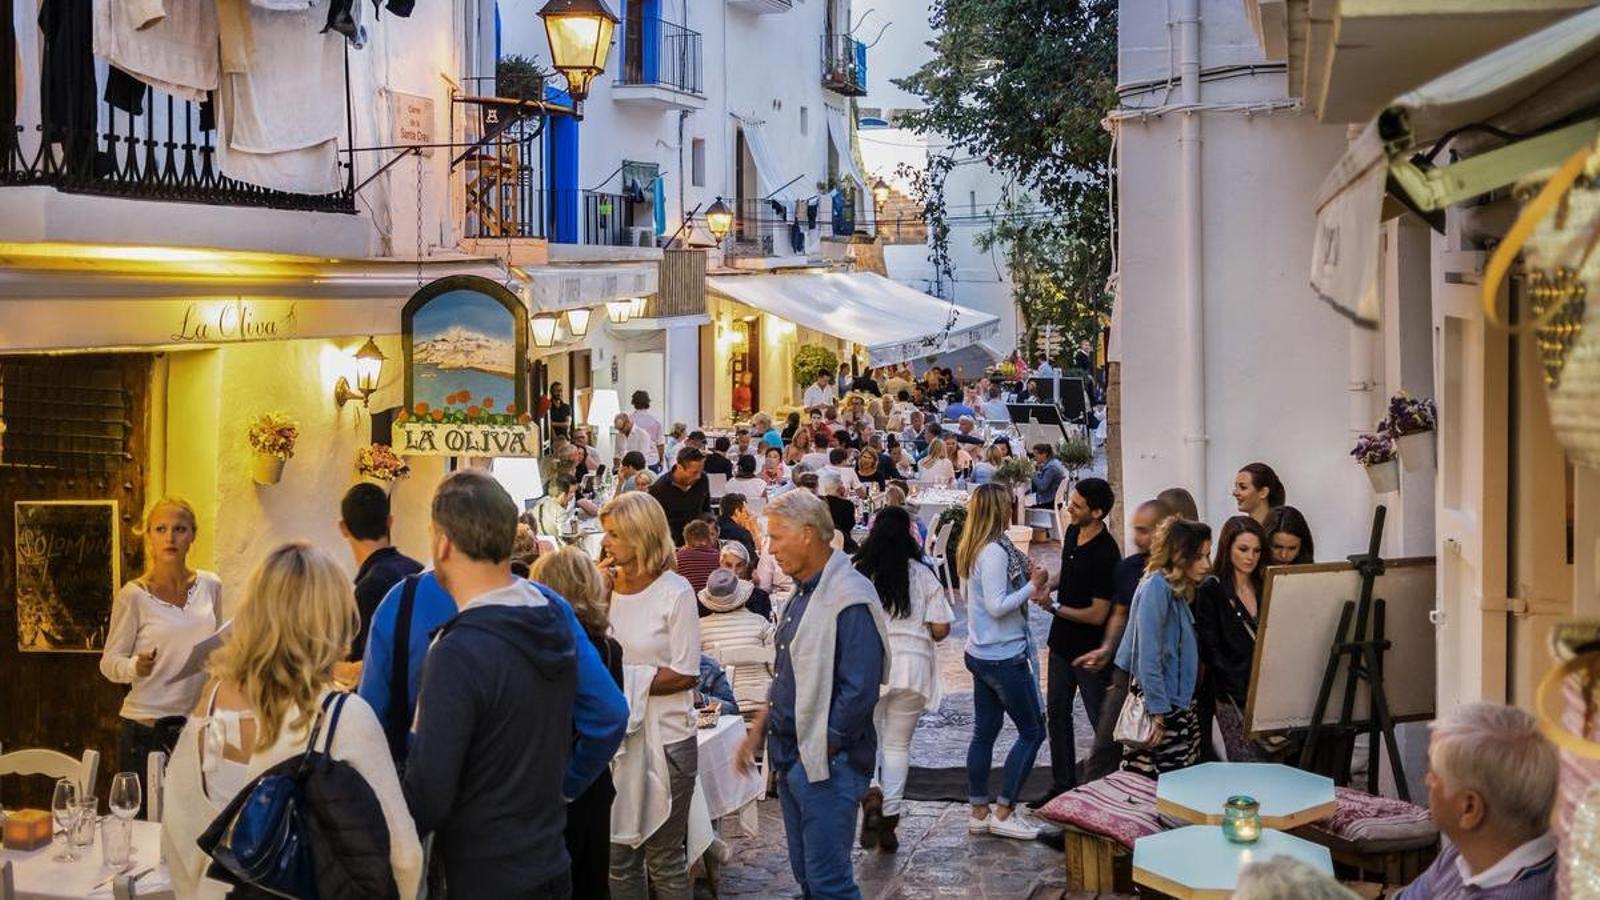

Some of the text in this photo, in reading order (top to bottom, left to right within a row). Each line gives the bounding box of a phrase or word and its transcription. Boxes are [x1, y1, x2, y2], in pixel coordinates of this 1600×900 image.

[171, 303, 278, 341] La Oliva
[405, 429, 532, 455] LA OLIVA
